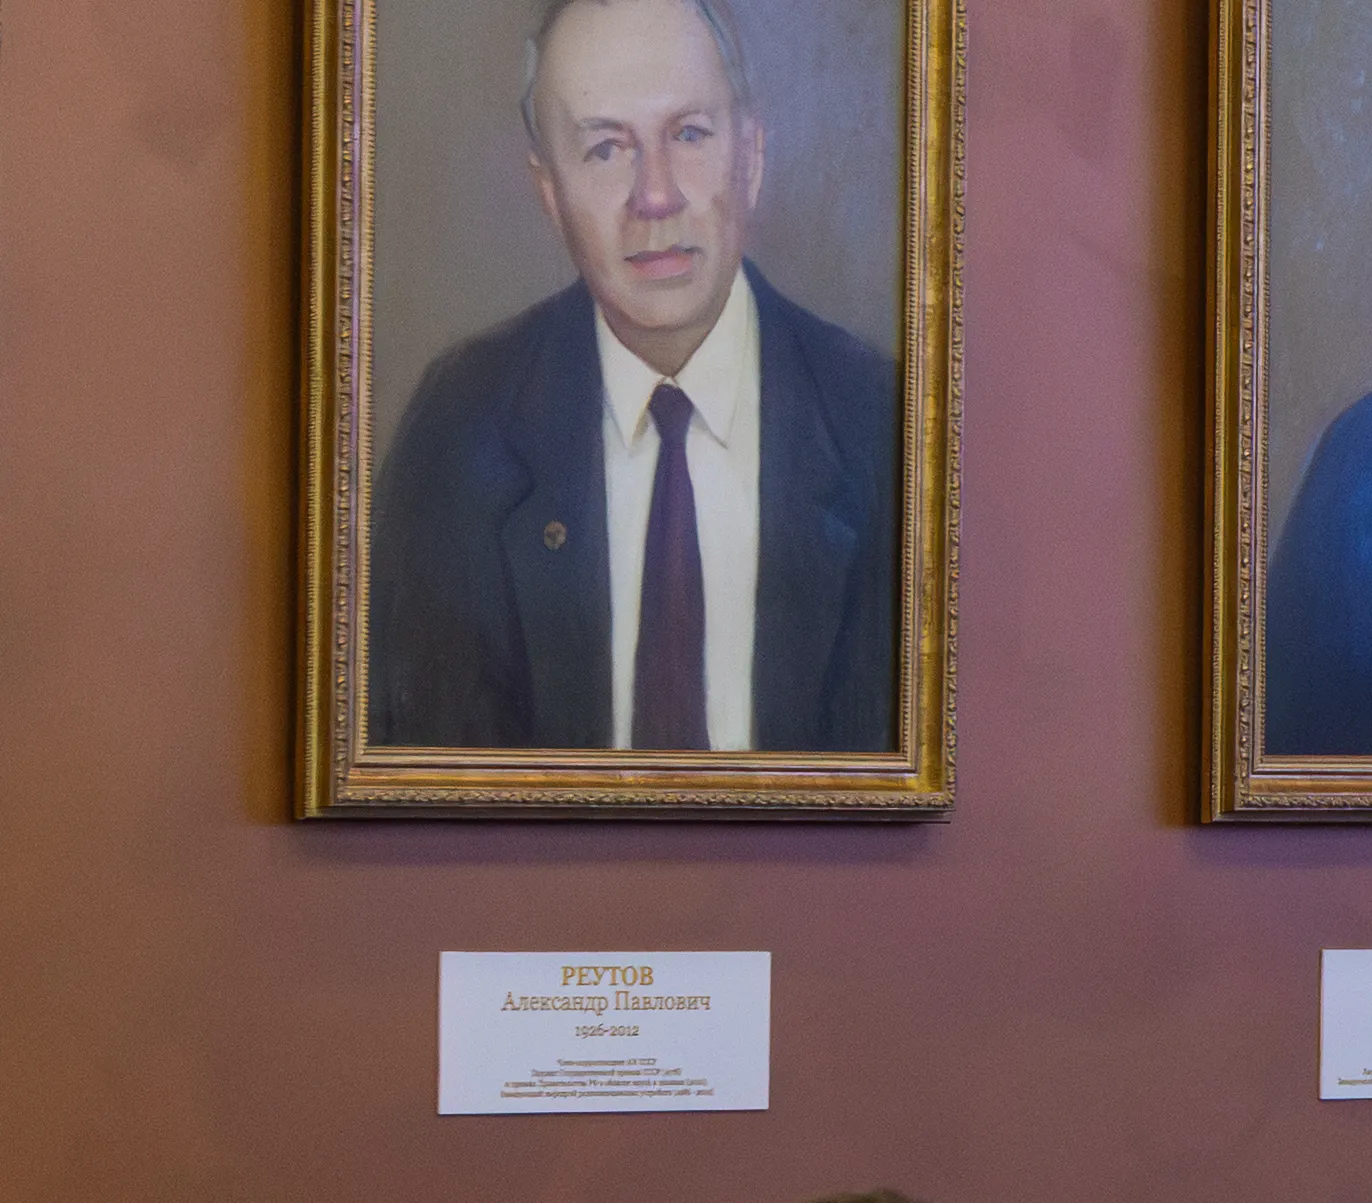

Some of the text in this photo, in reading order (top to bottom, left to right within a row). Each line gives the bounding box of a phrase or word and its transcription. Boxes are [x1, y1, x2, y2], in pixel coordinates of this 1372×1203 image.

[561, 966, 655, 987] РЕУТОВ
[501, 990, 711, 1017] Александр Павлович
